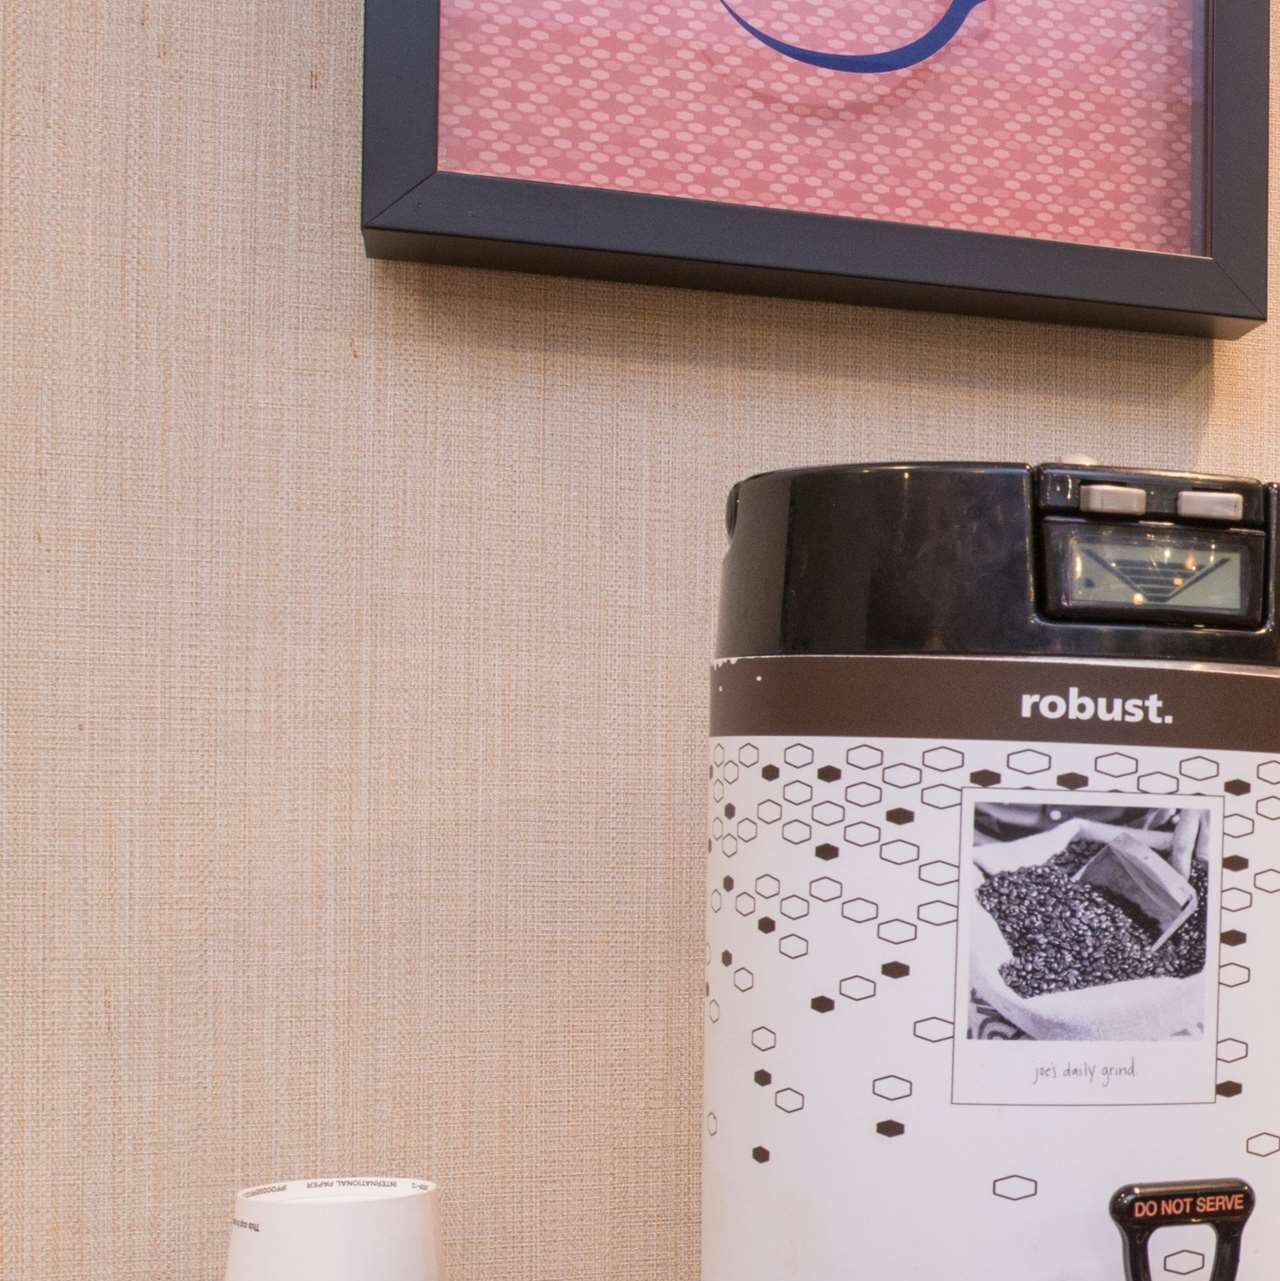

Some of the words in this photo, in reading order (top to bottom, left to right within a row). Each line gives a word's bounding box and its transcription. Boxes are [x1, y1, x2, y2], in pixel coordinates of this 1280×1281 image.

[1020, 687, 1174, 724] robust.
[1032, 1061, 1057, 1085] joe's
[1062, 1061, 1096, 1084] daily
[1101, 1056, 1136, 1087] grind
[306, 1181, 334, 1189] PAPER
[1134, 1201, 1158, 1217] DO
[1161, 1198, 1193, 1215] NOT
[1196, 1194, 1244, 1212] SERVE
